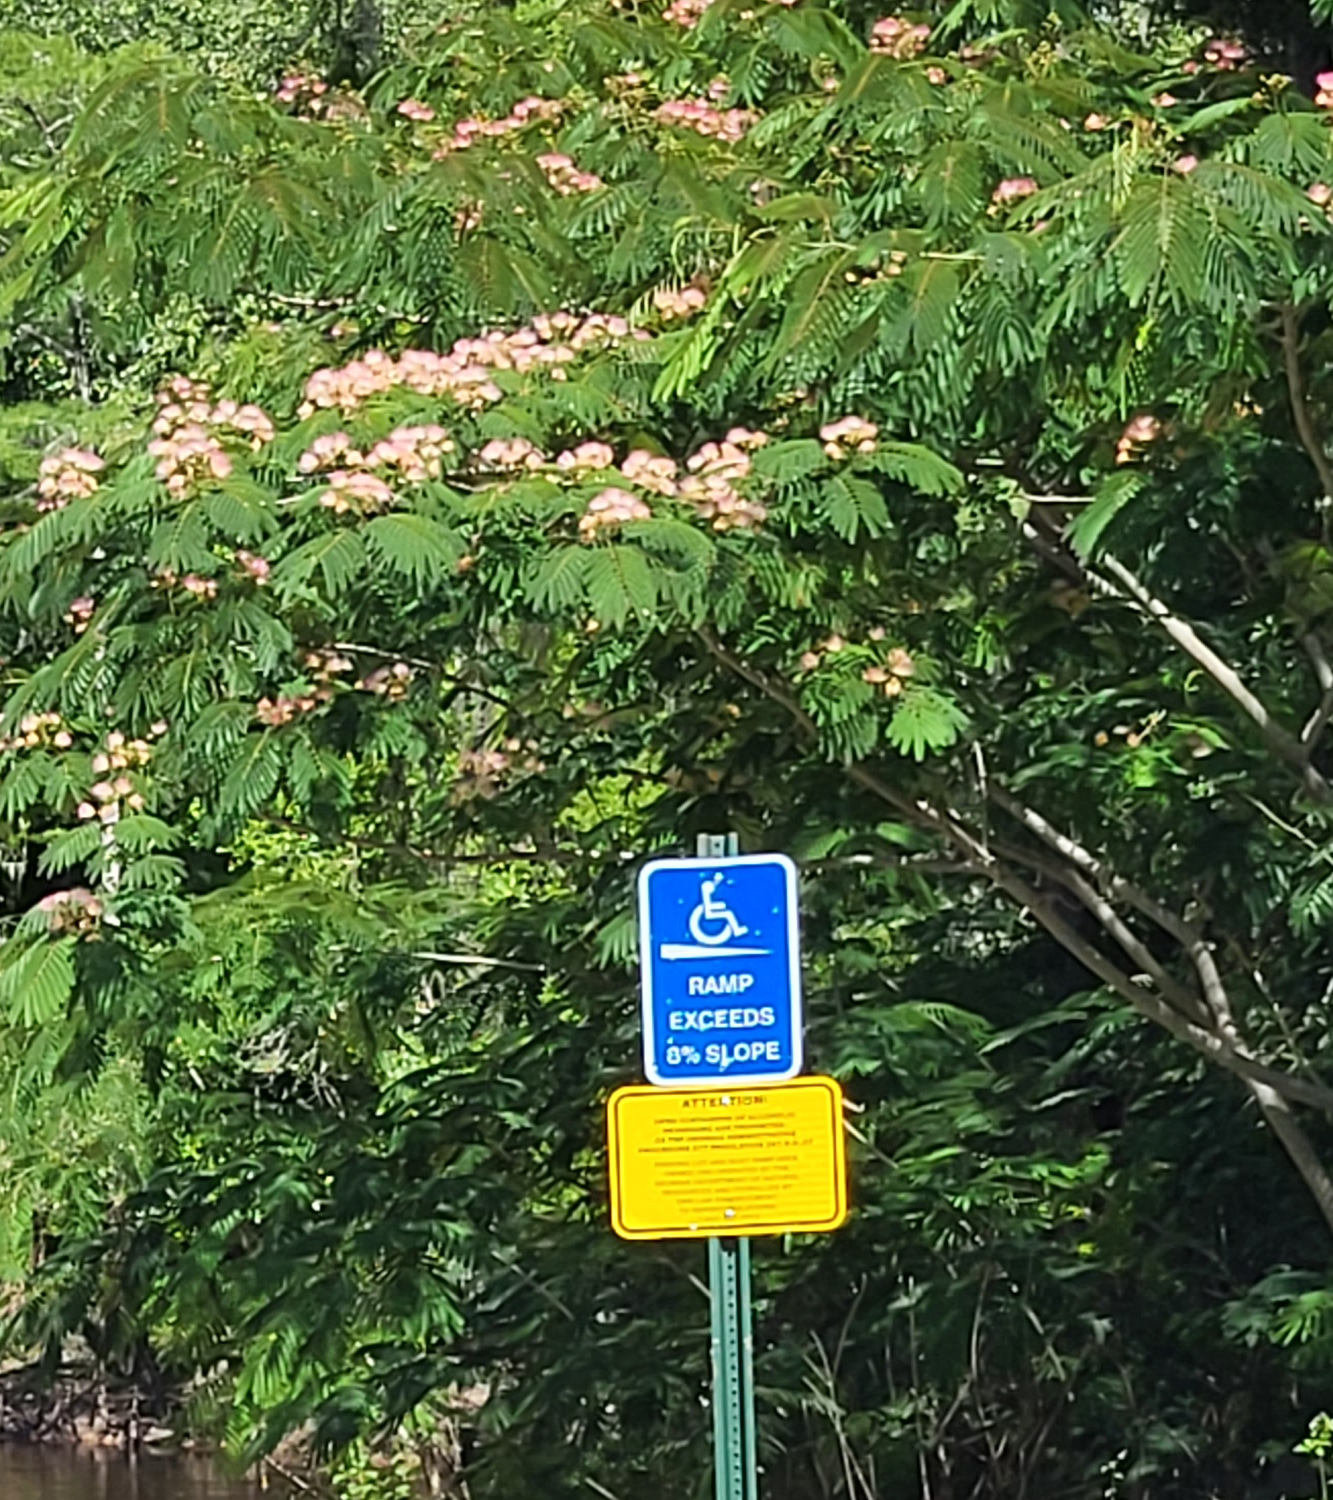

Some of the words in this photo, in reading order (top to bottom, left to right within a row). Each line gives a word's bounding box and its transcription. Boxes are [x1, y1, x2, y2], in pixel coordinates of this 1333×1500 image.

[689, 973, 754, 996] RAMP
[669, 1006, 776, 1031] EXCEEDS
[666, 1045, 702, 1065] 8%
[705, 1040, 782, 1064] SLOPE
